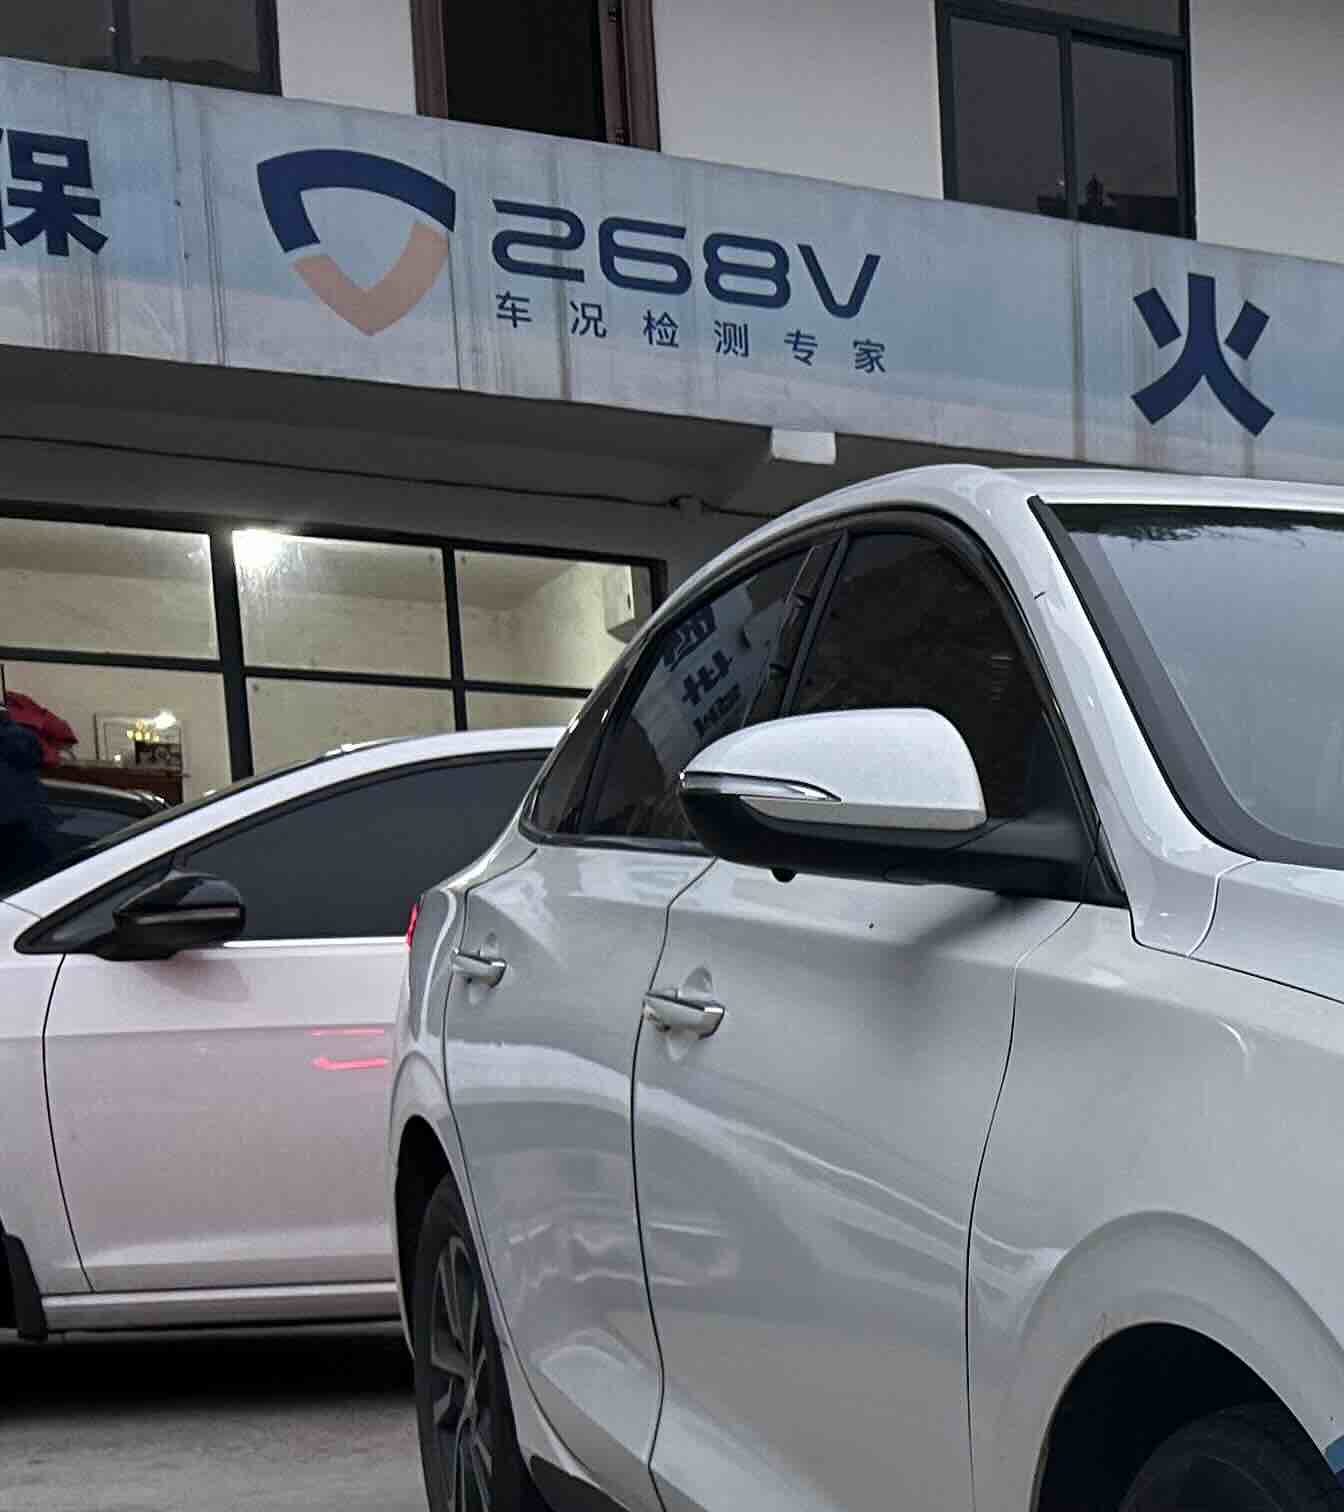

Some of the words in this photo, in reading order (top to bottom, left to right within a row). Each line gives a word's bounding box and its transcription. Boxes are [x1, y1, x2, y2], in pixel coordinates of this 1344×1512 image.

[0, 128, 109, 257] 保
[491, 199, 881, 319] 268V
[495, 291, 887, 374] 车况检测专家
